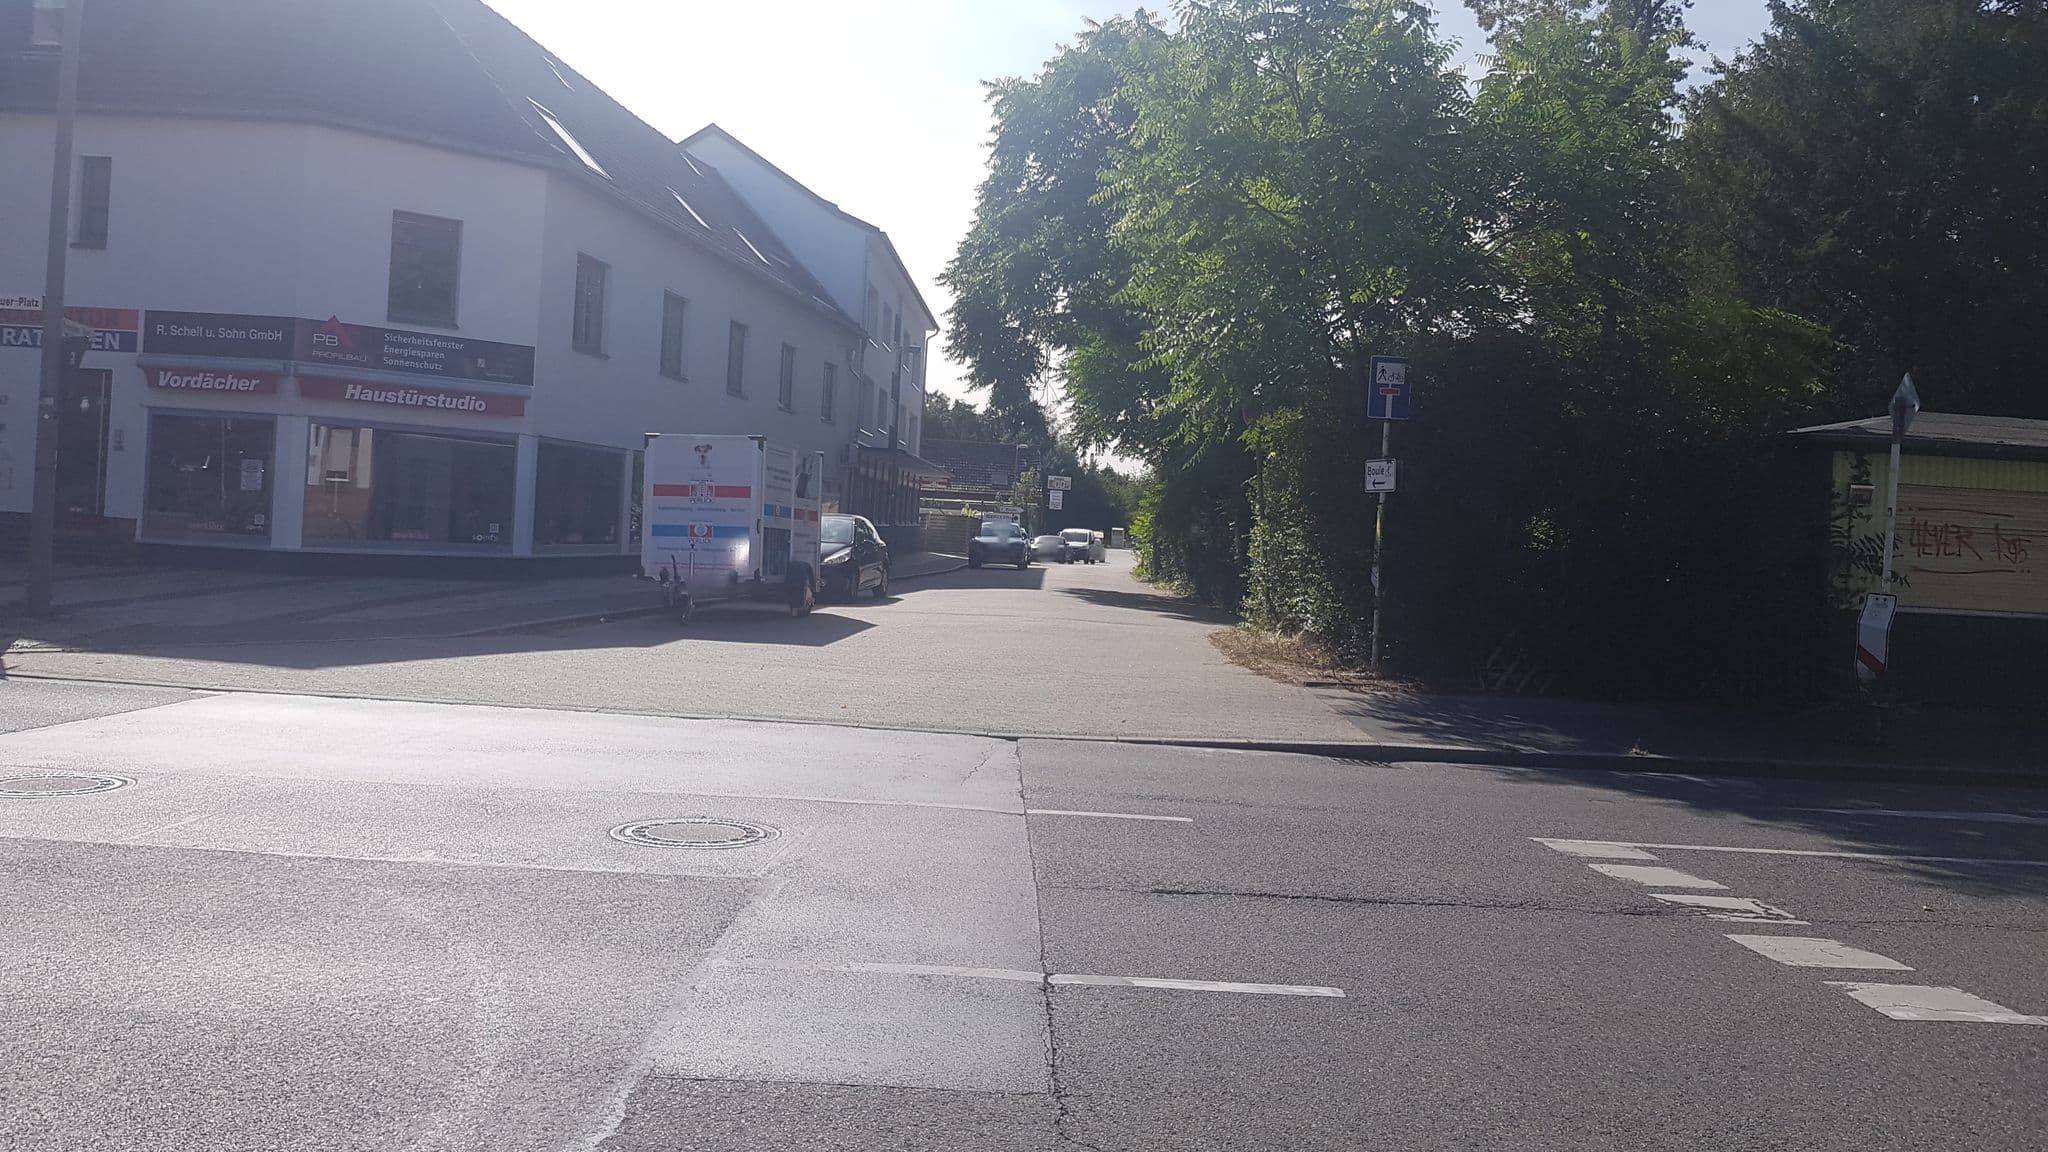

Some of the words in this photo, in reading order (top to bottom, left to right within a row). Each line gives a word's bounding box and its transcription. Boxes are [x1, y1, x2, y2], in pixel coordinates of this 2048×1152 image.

[156, 324, 167, 335] R.
[206, 329, 215, 338] u.
[218, 328, 245, 340] Sohn
[249, 329, 283, 342] GmbH
[312, 333, 338, 346] PB
[383, 333, 464, 350] Sicherheitsfenster
[383, 345, 446, 360] Energiesparen
[383, 357, 443, 371] Sonnenschutz
[158, 371, 261, 392] Vordächer
[345, 384, 487, 412] Haustürstudio
